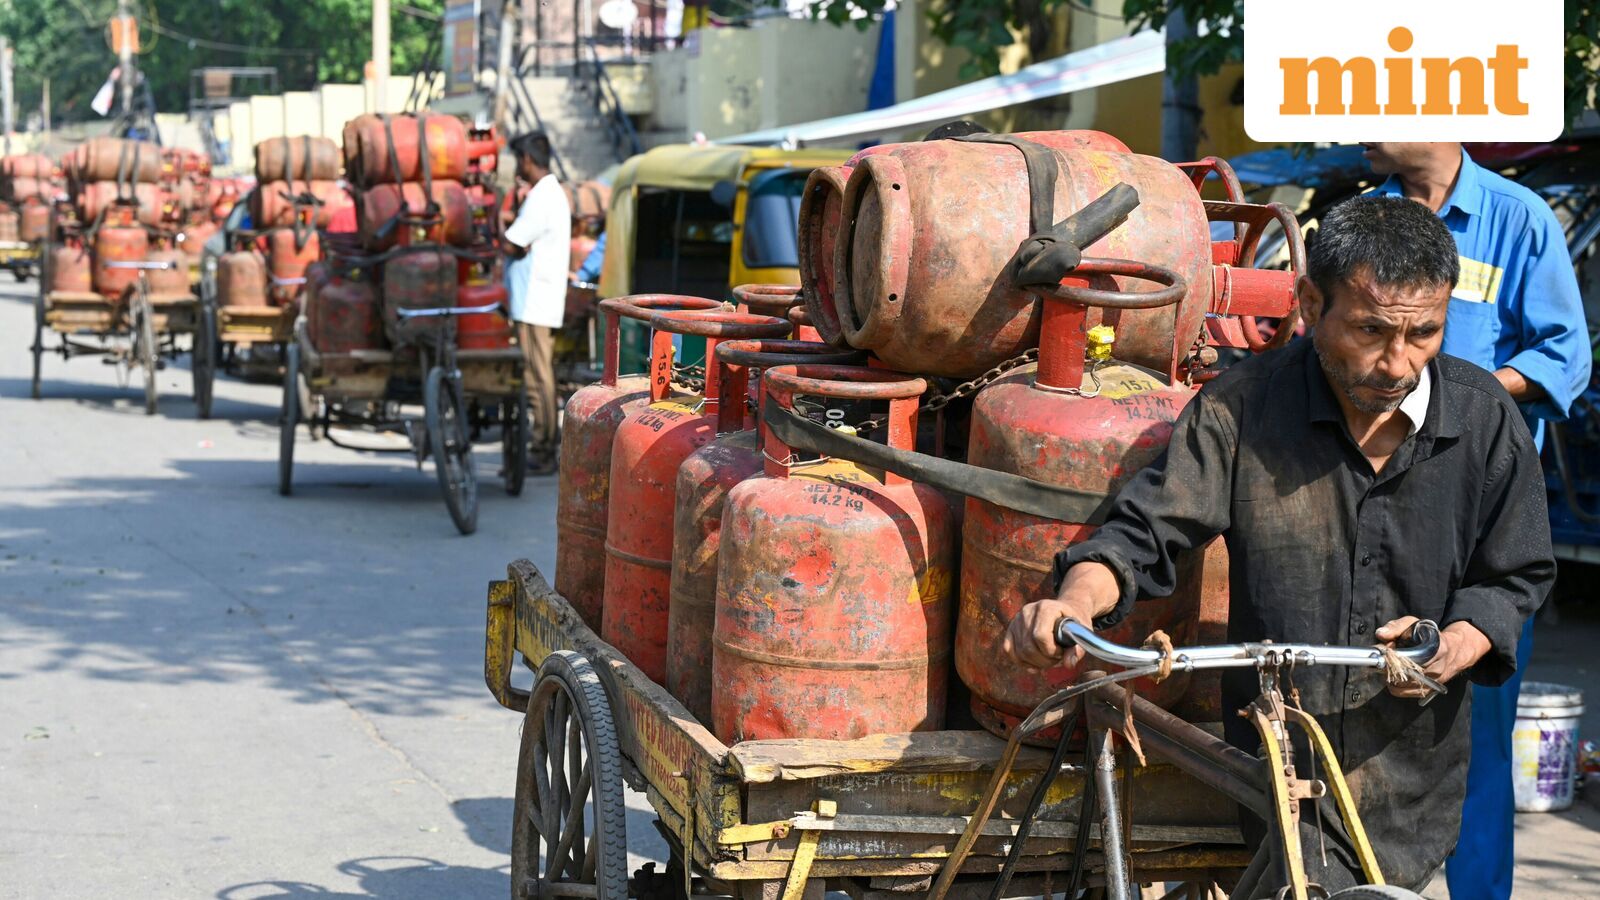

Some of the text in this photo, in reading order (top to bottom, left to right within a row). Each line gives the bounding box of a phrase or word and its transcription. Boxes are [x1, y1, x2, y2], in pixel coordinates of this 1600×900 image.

[657, 353, 667, 386] 15.6
[811, 493, 864, 513] 14.2 kg
